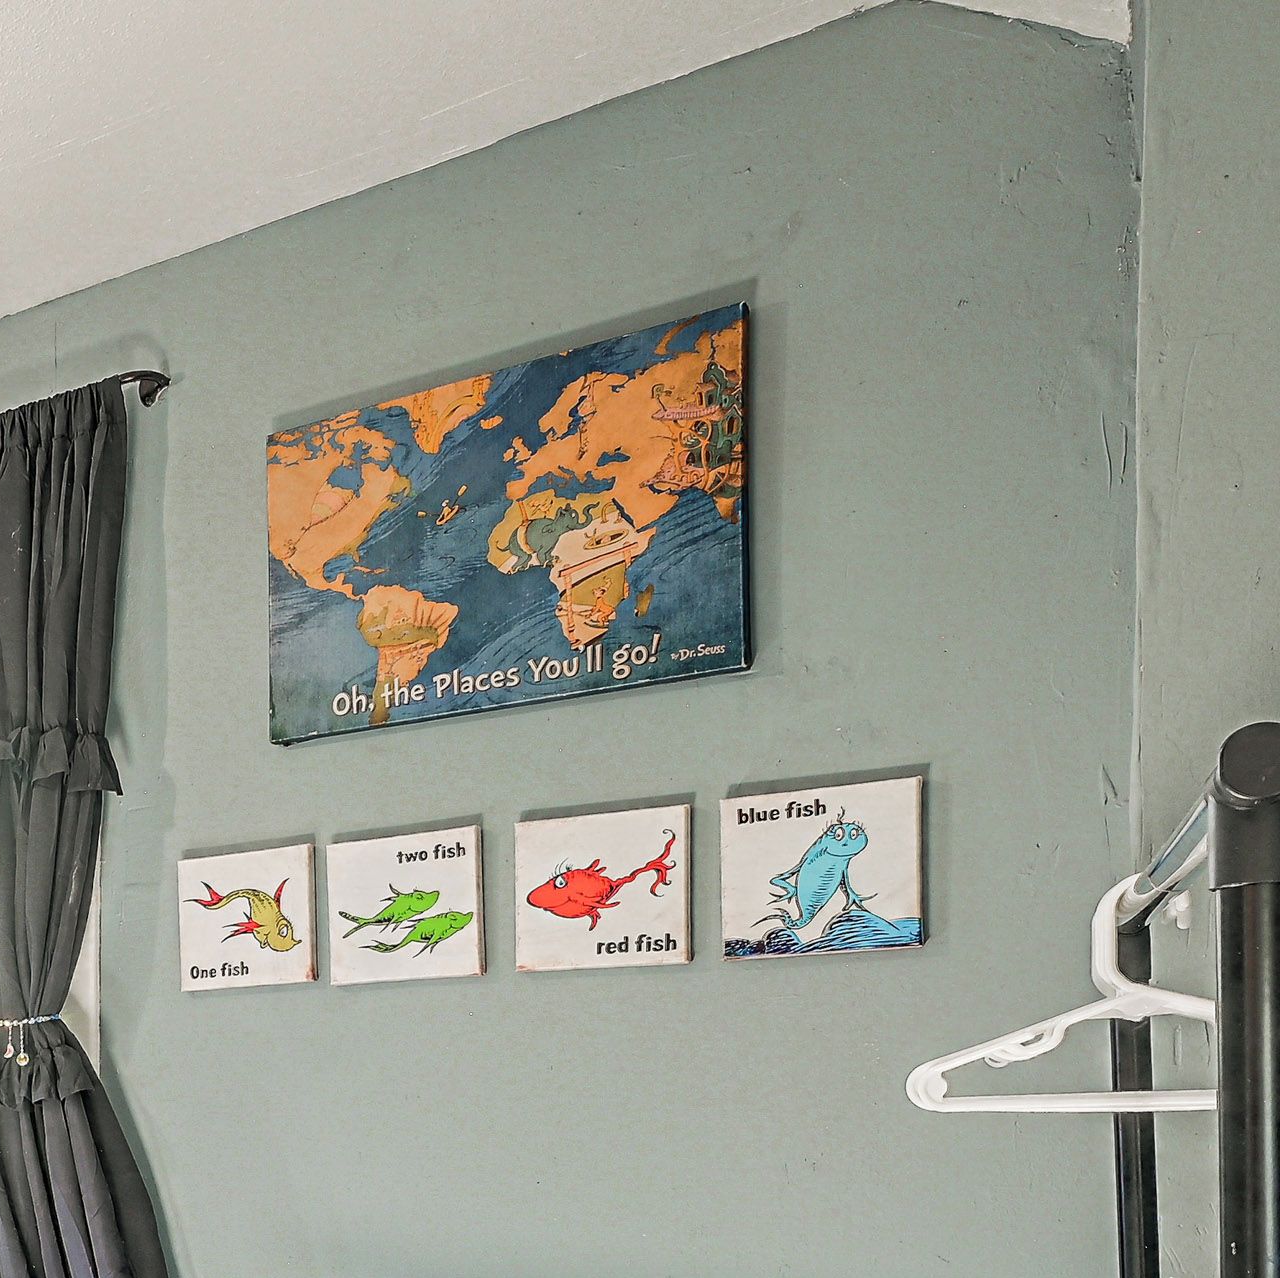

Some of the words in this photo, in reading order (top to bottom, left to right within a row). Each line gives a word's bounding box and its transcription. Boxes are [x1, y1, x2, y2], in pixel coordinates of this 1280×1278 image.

[679, 648, 696, 661] Dr.
[697, 643, 726, 656] Seuss
[332, 685, 374, 717] Oh,
[380, 675, 426, 709] the
[433, 667, 521, 699] Places
[529, 643, 602, 683] You'll
[611, 633, 660, 679] go!
[737, 807, 780, 825] blue
[785, 798, 826, 819] fish
[396, 850, 428, 864] two
[433, 841, 466, 860] fish
[596, 935, 629, 955] red
[635, 931, 677, 953] fish
[190, 965, 217, 979] One
[220, 960, 249, 977] fish
